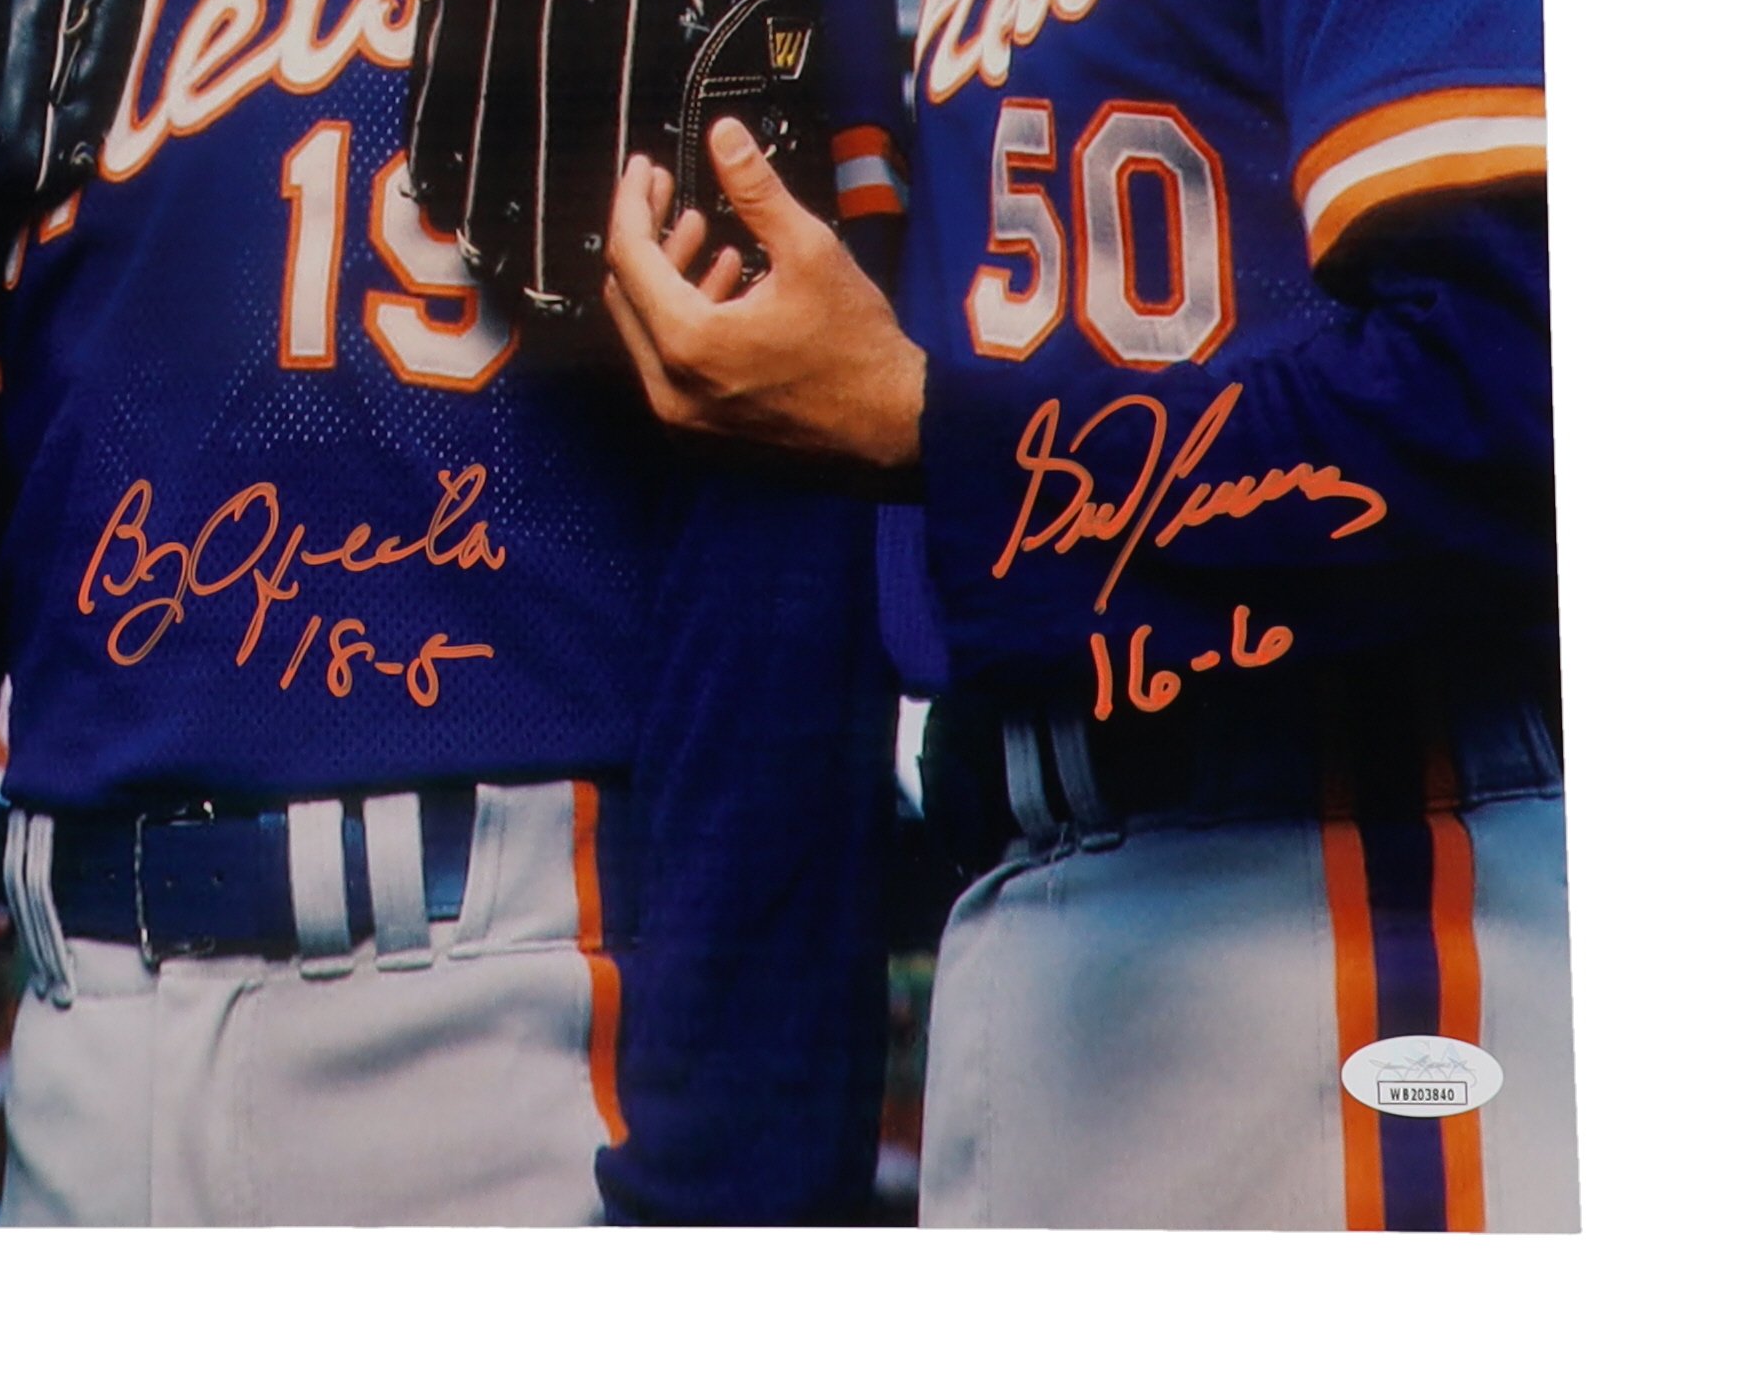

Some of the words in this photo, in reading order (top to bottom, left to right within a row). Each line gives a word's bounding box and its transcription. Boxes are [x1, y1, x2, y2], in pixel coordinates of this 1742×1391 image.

[278, 119, 521, 393] 19
[964, 98, 1237, 372] 50
[1089, 603, 1294, 722] 16-6
[1389, 1087, 1455, 1102] WB203840
